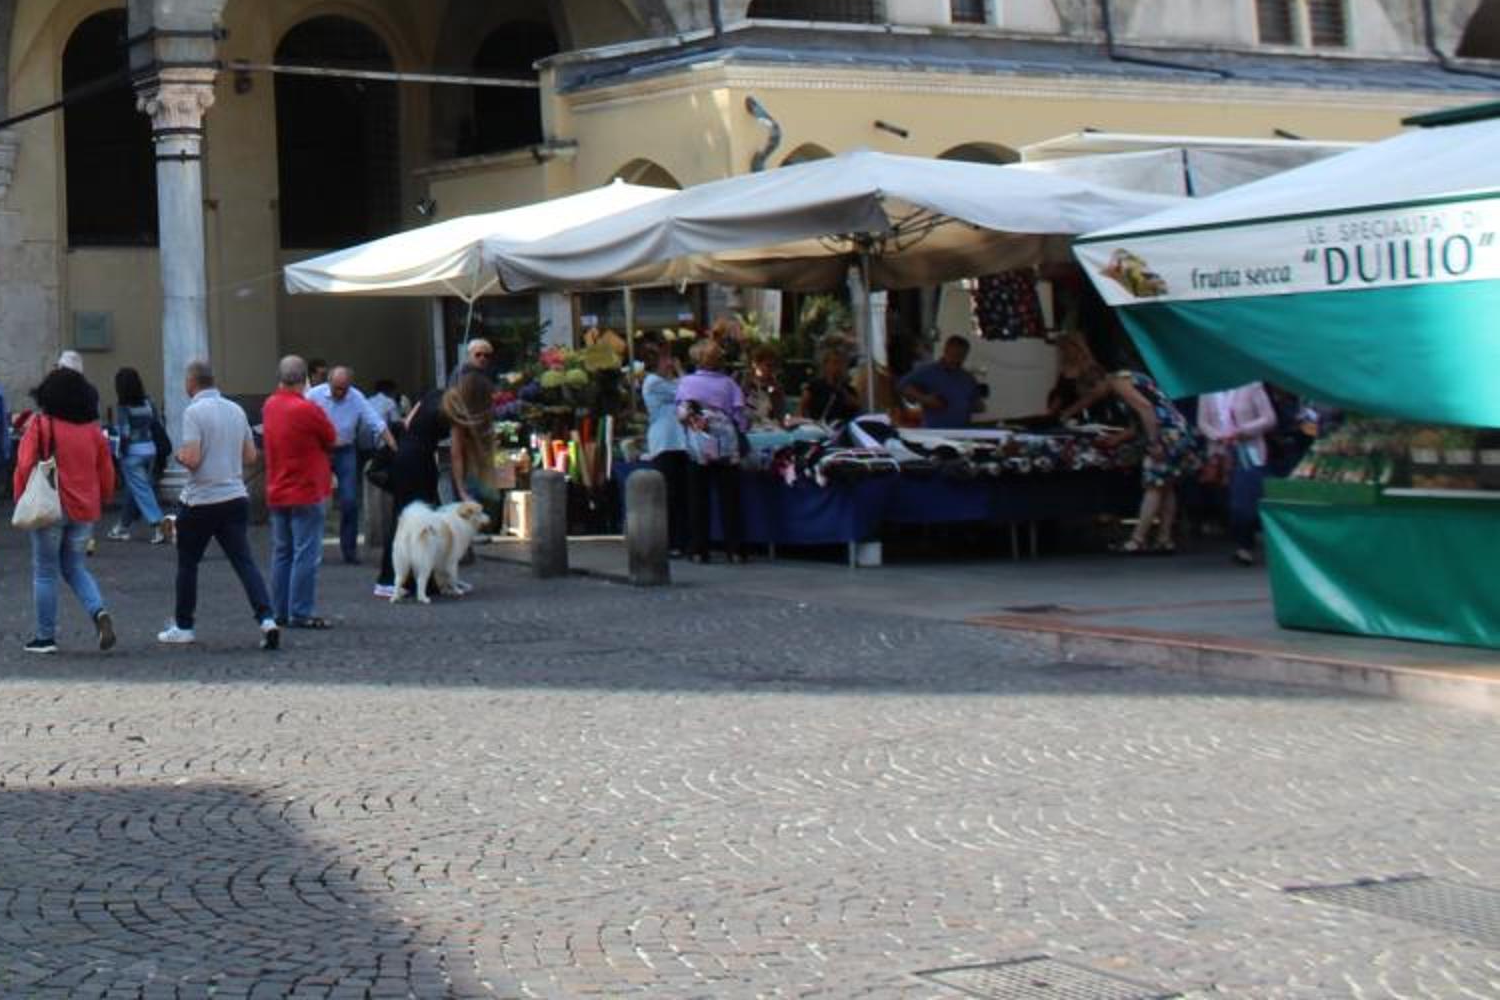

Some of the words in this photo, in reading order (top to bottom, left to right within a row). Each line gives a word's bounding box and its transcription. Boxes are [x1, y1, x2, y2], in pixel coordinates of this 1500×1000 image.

[1307, 226, 1326, 245] LE
[1191, 267, 1241, 290] frutta
[1246, 265, 1291, 286] secca
